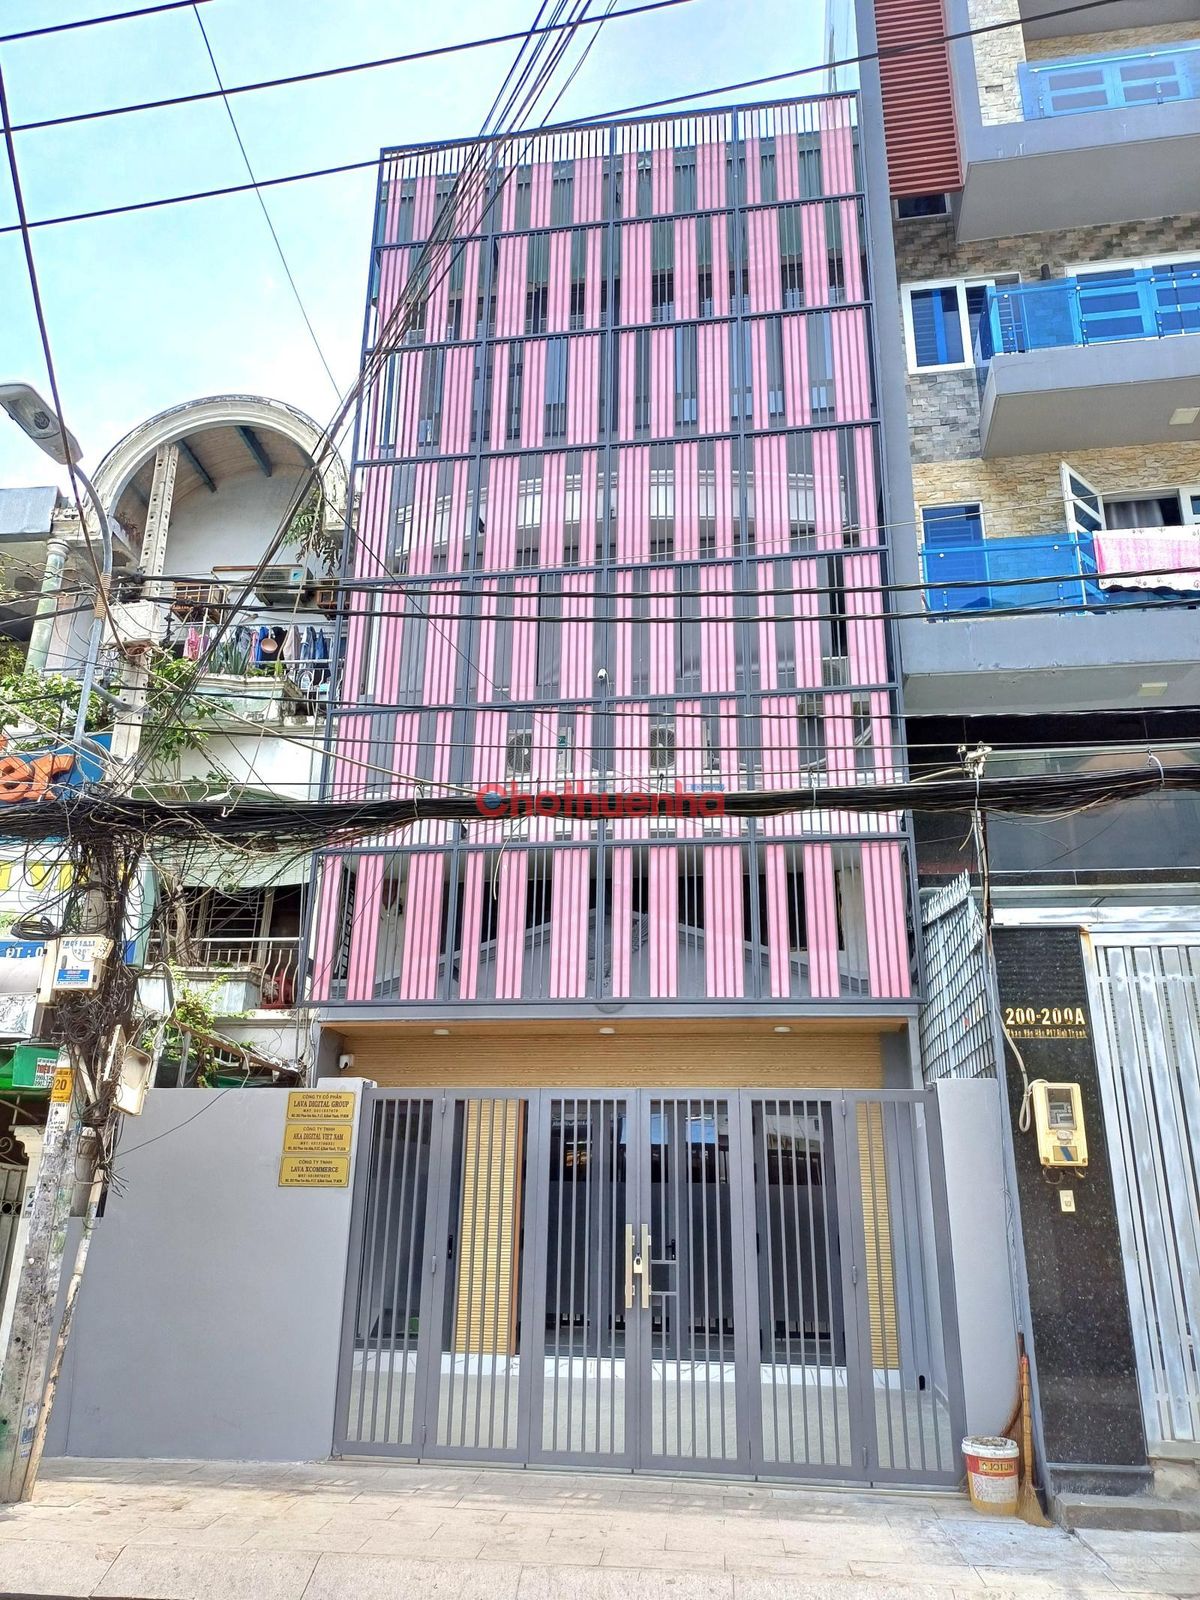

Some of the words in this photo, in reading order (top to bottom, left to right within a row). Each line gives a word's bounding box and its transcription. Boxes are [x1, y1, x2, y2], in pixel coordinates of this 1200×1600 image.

[1005, 1007, 1086, 1025] 200-200A
[54, 1078, 68, 1091] 20
[333, 1133, 344, 1141] NAM
[989, 1463, 1014, 1471] JOTUN
